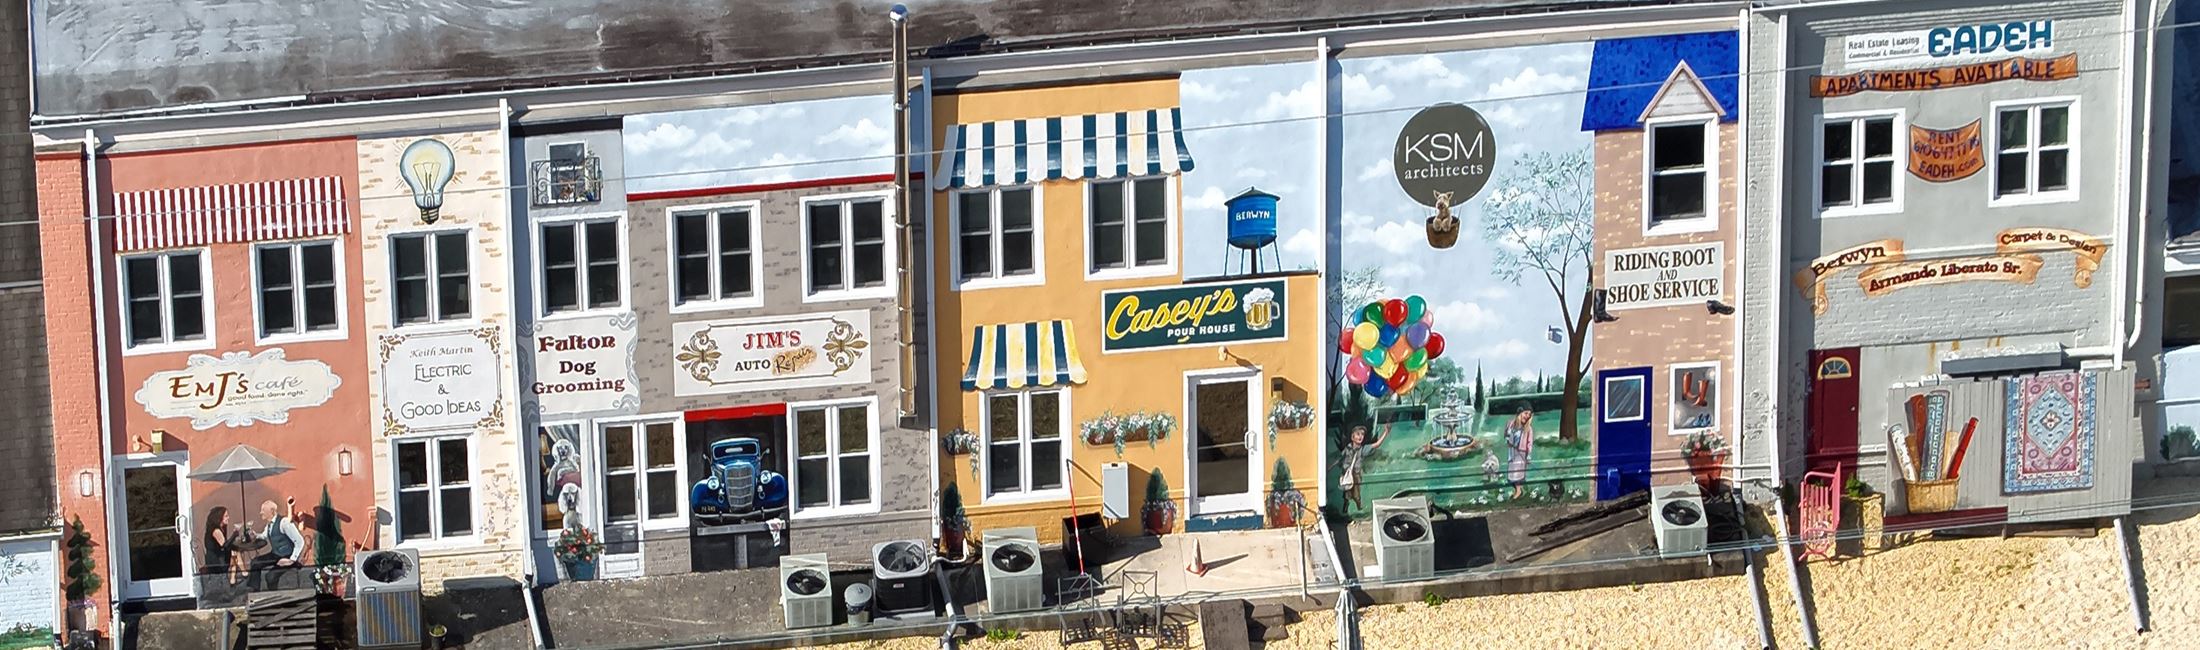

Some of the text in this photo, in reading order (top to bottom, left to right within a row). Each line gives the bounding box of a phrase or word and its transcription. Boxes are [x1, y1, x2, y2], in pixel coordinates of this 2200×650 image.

[1848, 37, 1920, 50] Real Estate Leasing
[1928, 20, 2053, 57] EADEH
[1824, 70, 1942, 96] APARTMENTS
[1405, 130, 1483, 164] KSM
[1404, 162, 1484, 180] architects
[1235, 210, 1270, 221] BERWYN
[2001, 230, 2097, 255] Carpet & Design
[1613, 247, 1716, 272] RIDING BOOT
[1811, 245, 1886, 278] Berwyn
[1656, 269, 1678, 282] AND
[1869, 261, 2023, 292] Armando Liberato Sr.
[1608, 278, 1719, 305] SHOE SERVICE
[1106, 287, 1238, 341] Casey's
[743, 330, 802, 350] JIM'S
[1167, 323, 1236, 338] POUR HOUSE
[409, 345, 473, 358] Keith Martin
[538, 334, 616, 353] Fulton
[559, 360, 597, 375] Dog
[735, 347, 813, 374] AUTO Repair
[254, 376, 304, 391] café
[437, 383, 450, 395] &
[531, 378, 625, 395] Grooming
[401, 399, 481, 420] GOOD IDEAS
